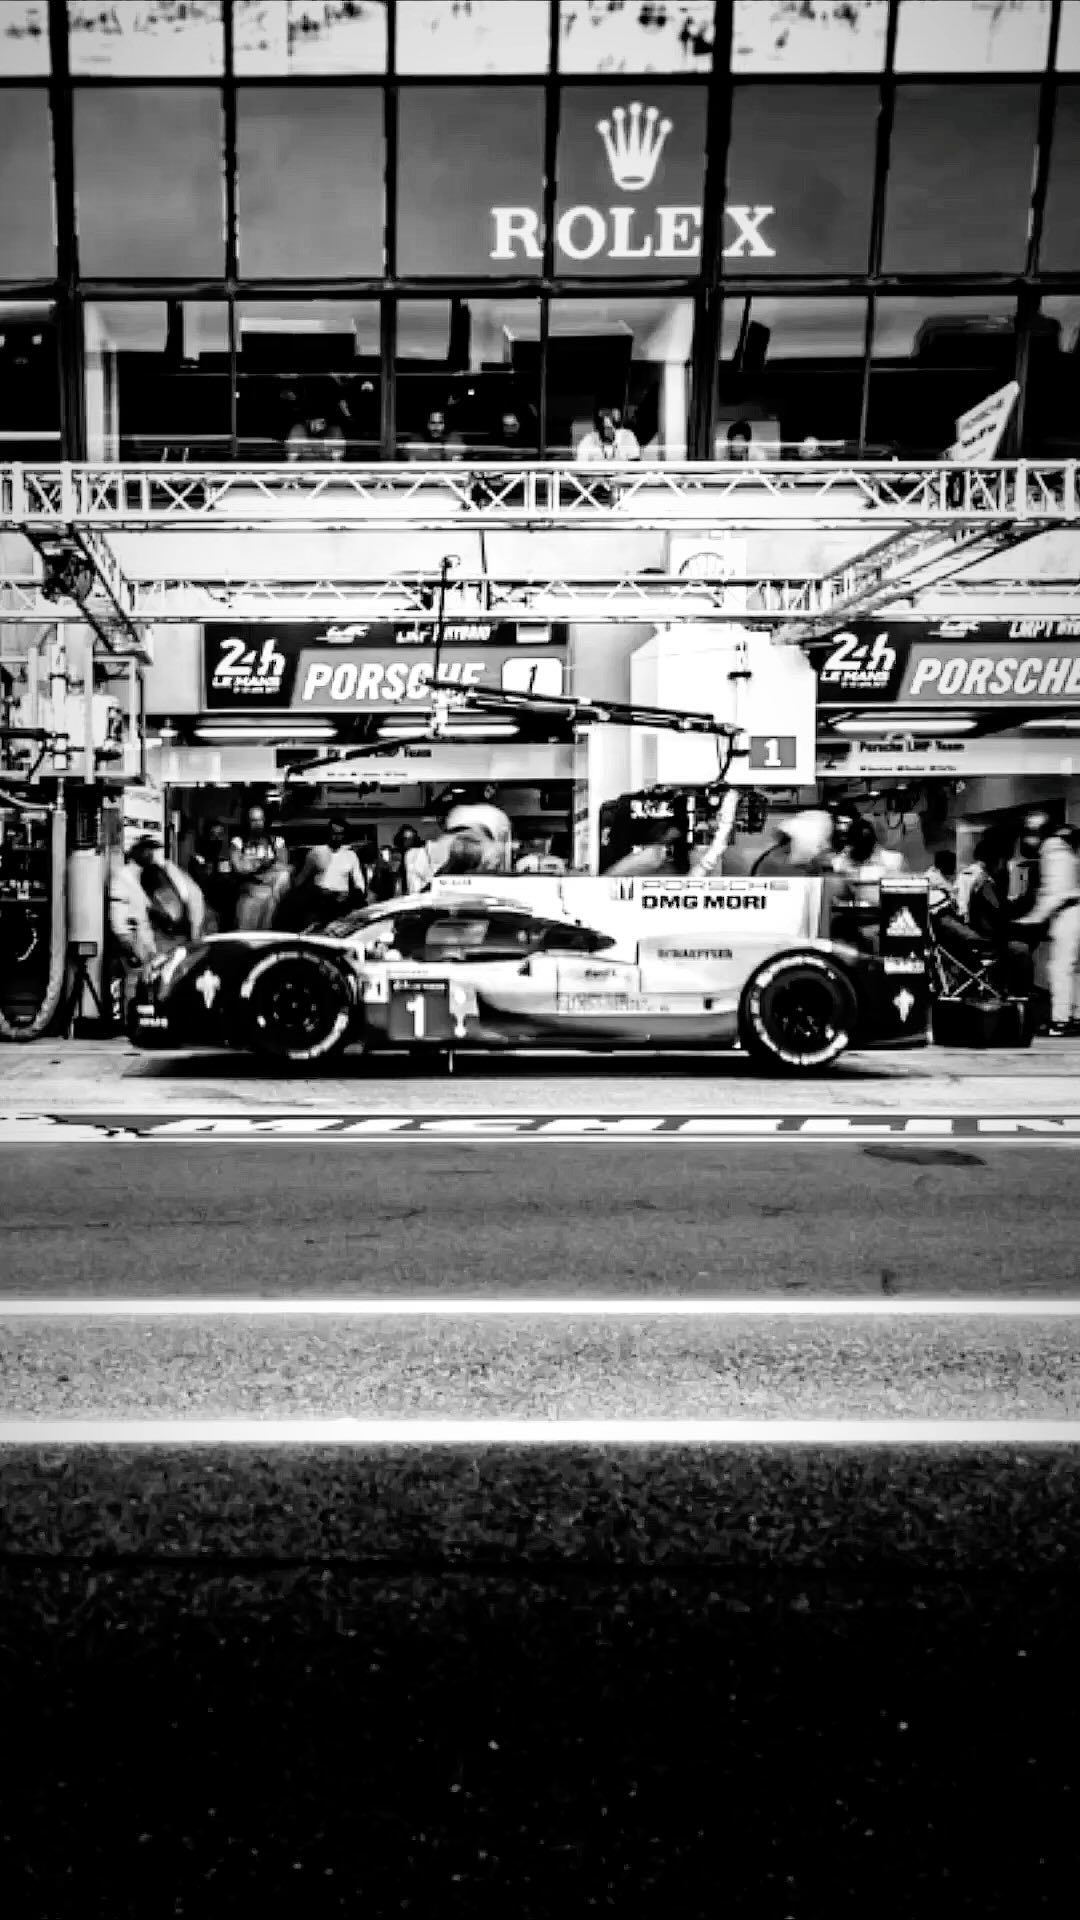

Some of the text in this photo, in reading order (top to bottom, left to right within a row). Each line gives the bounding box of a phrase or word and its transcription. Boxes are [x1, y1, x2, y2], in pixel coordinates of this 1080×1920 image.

[490, 205, 776, 259] ROLEX
[214, 638, 286, 676] 24h
[823, 632, 896, 671] 24h
[764, 738, 781, 767] 1
[641, 895, 767, 910] DMG MORI
[406, 993, 425, 1037] 1
